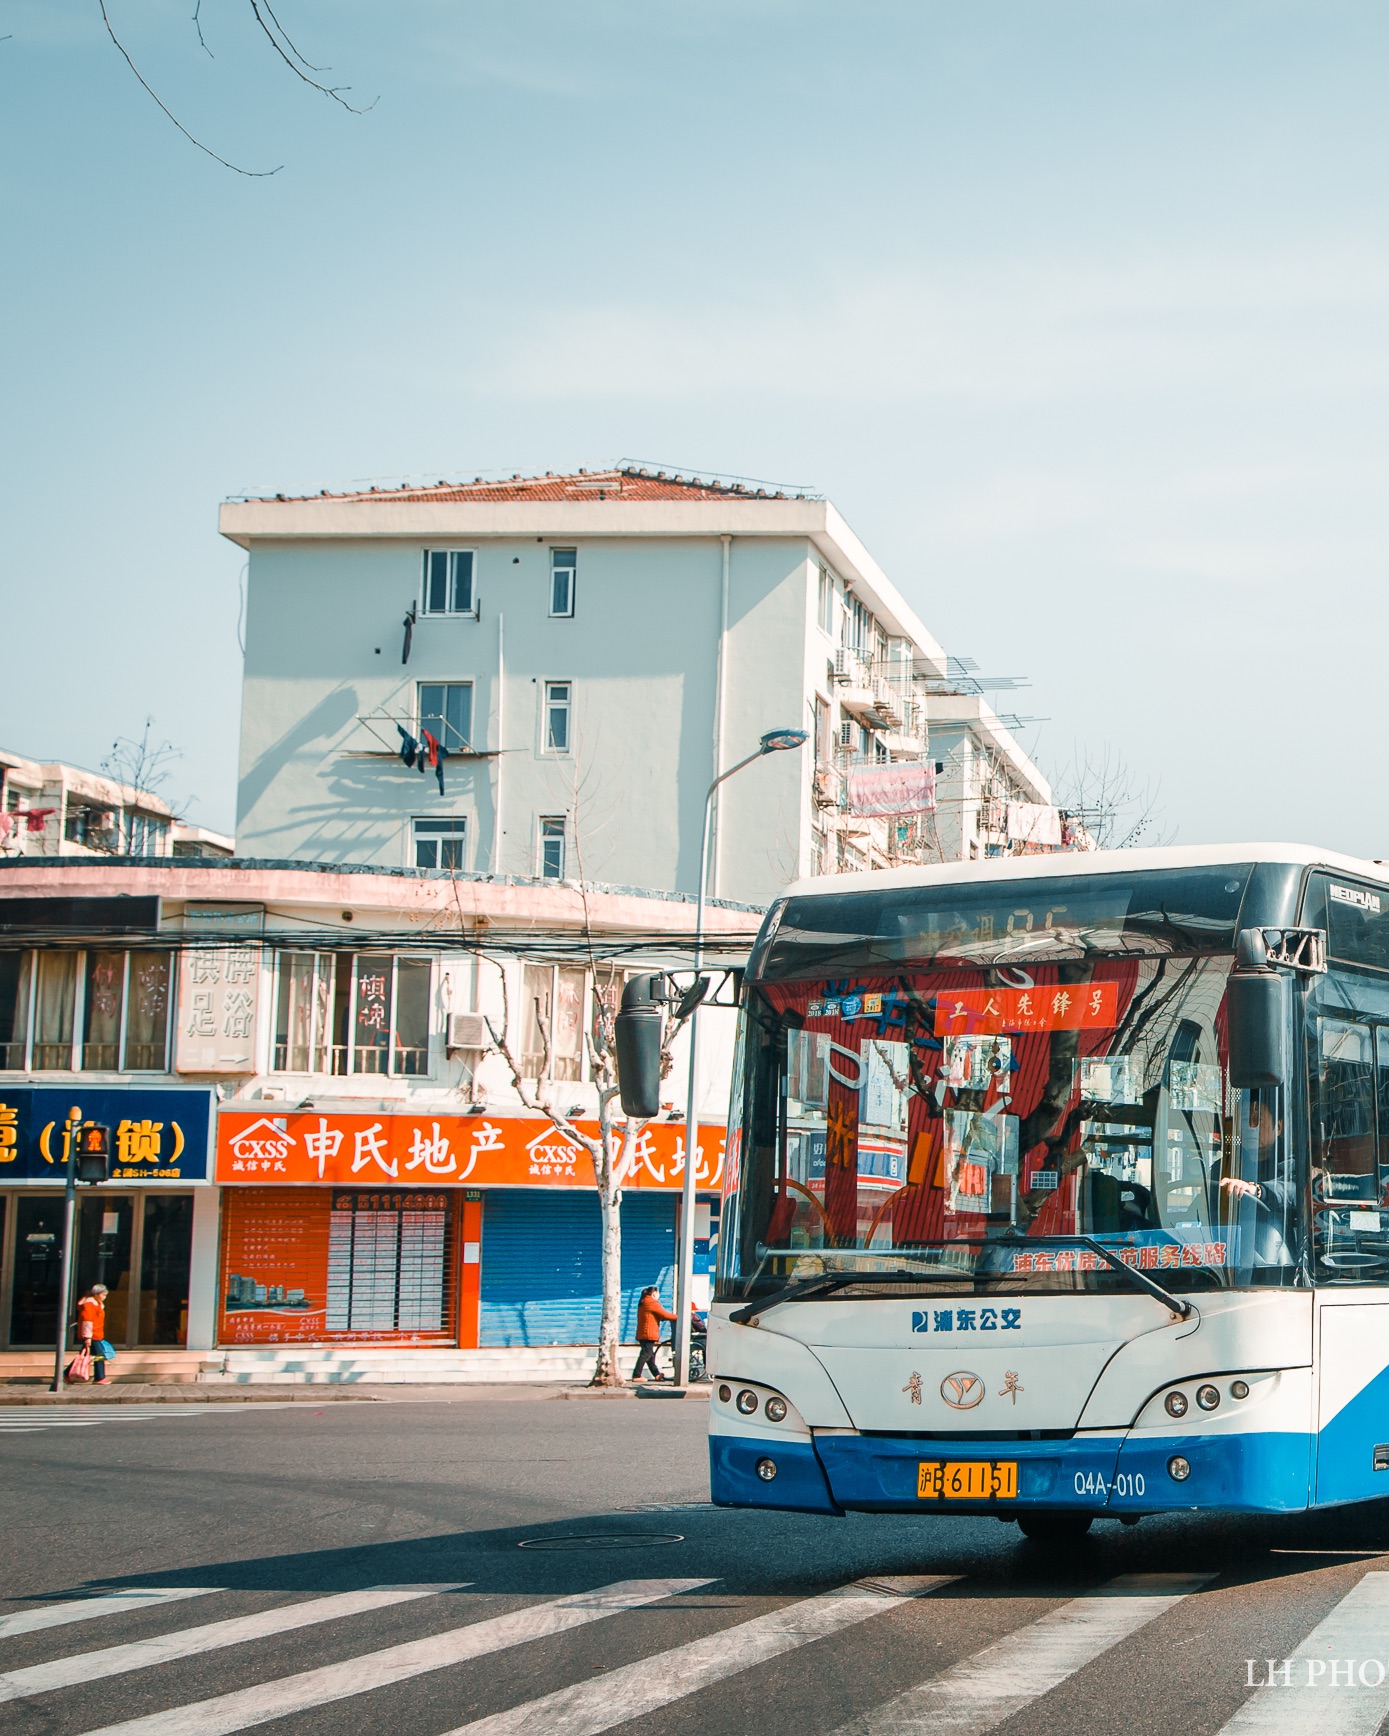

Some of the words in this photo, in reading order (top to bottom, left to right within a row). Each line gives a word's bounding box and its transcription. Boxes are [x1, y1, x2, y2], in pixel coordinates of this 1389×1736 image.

[1329, 884, 1381, 912] NEOPLAN
[186, 988, 253, 1039] 足浴
[949, 989, 1103, 1019] 工人先锋号
[233, 1139, 289, 1159] CXSS
[303, 1117, 506, 1180] 申氏地产
[529, 1145, 577, 1164] CXSS
[933, 1308, 1022, 1332] 浦东公交
